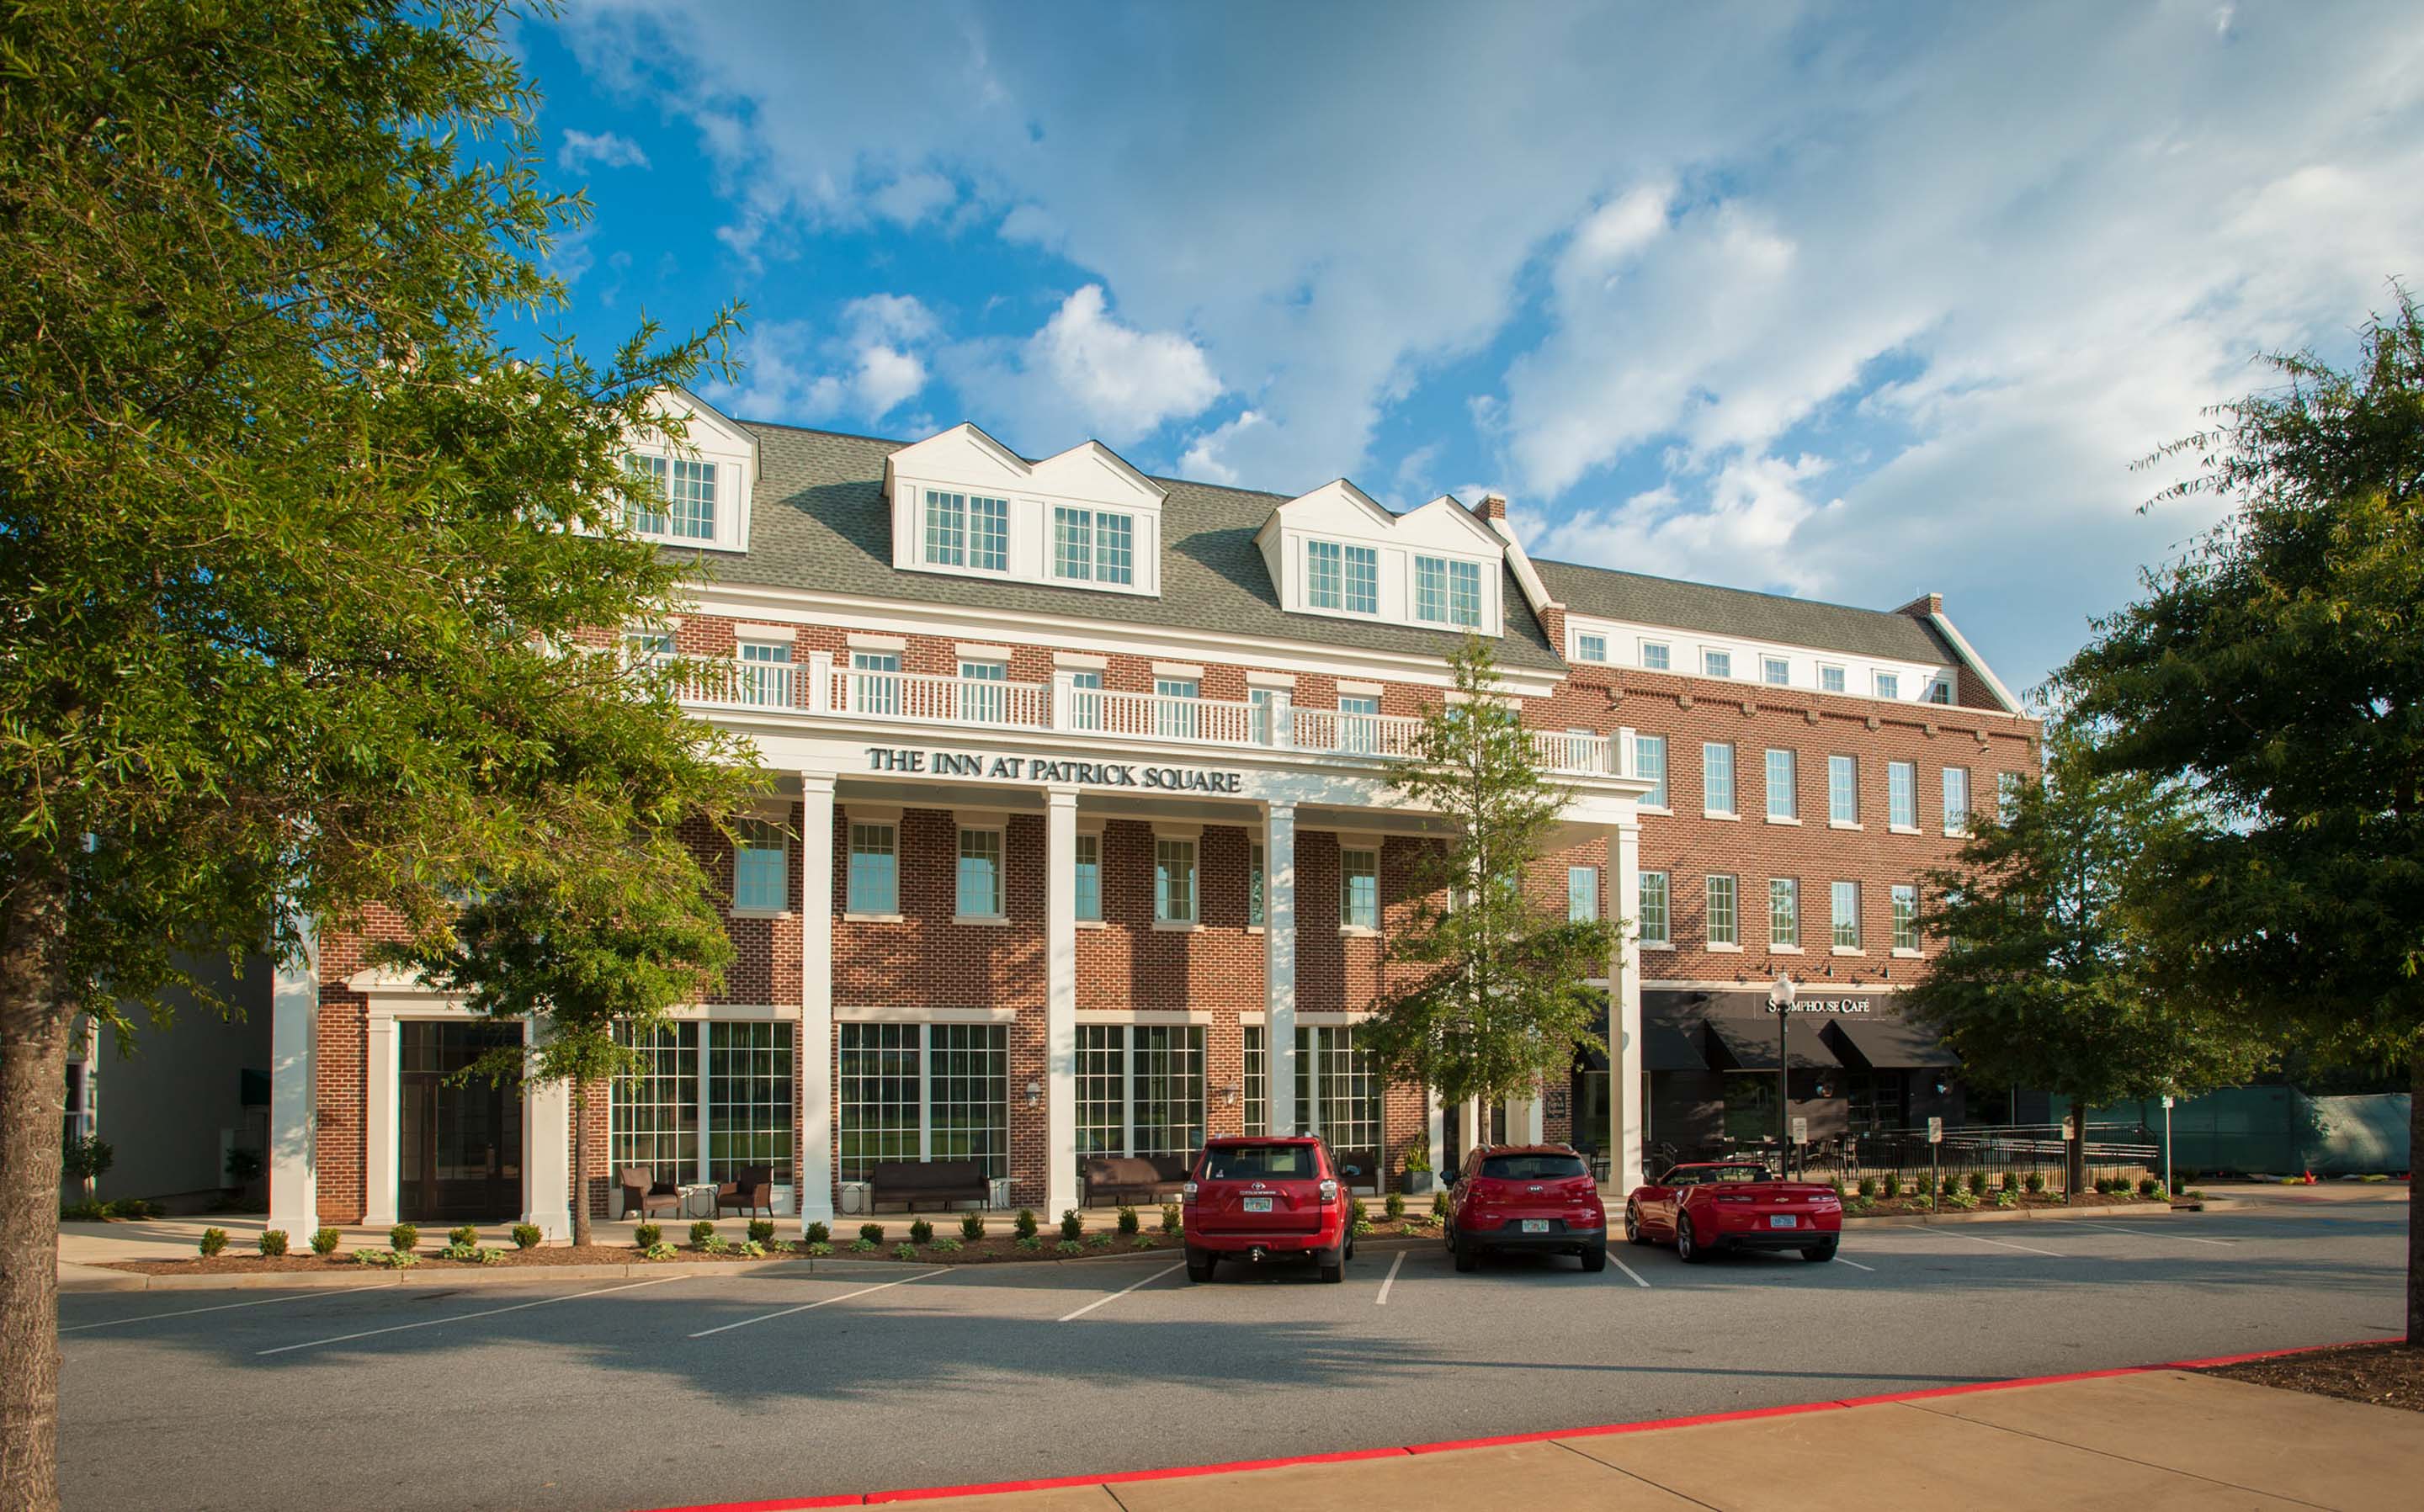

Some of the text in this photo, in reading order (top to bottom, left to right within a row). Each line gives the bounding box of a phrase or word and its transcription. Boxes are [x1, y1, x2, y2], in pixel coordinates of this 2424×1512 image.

[866, 747, 1242, 793] THE INN AT PATRICK SQUARE
[1768, 998, 1839, 1013] SMPHOUSE
